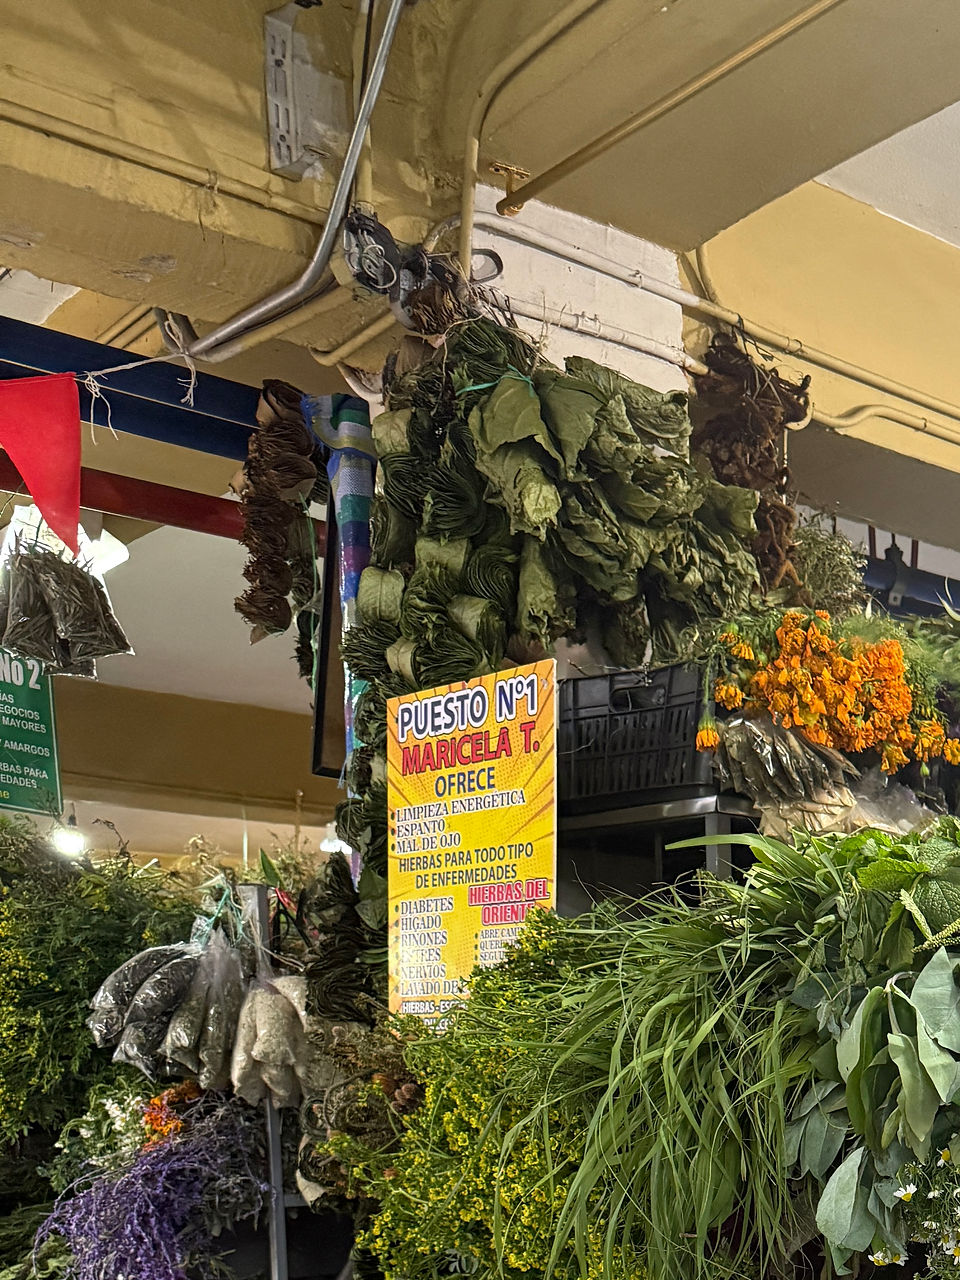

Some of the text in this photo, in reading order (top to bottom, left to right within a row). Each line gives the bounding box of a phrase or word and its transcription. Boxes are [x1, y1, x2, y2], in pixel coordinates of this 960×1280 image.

[28, 660, 41, 690] 2
[399, 687, 488, 741] PUESTO
[2, 716, 46, 733] MAYORES
[4, 740, 50, 757] AMARGOS
[402, 721, 540, 776] MARICELA T.
[24, 766, 49, 780] PARA
[434, 767, 496, 797] OFRECE
[396, 790, 525, 823] LIMPIEZA ENERGÉTICA
[397, 819, 446, 838] ESPANTO
[397, 833, 461, 854] MAL DE OJO
[399, 842, 533, 872] HIERBAS PARA TODO TIPO
[416, 864, 517, 889] DE ENFERMEDADES
[469, 878, 550, 906] HIERBAS DEL
[401, 897, 454, 914] DIABETES
[480, 929, 500, 939] ABRE
[401, 964, 446, 979] NERVIOS
[401, 981, 441, 996] LAVADO
[402, 1000, 435, 1015] HIERBAS
